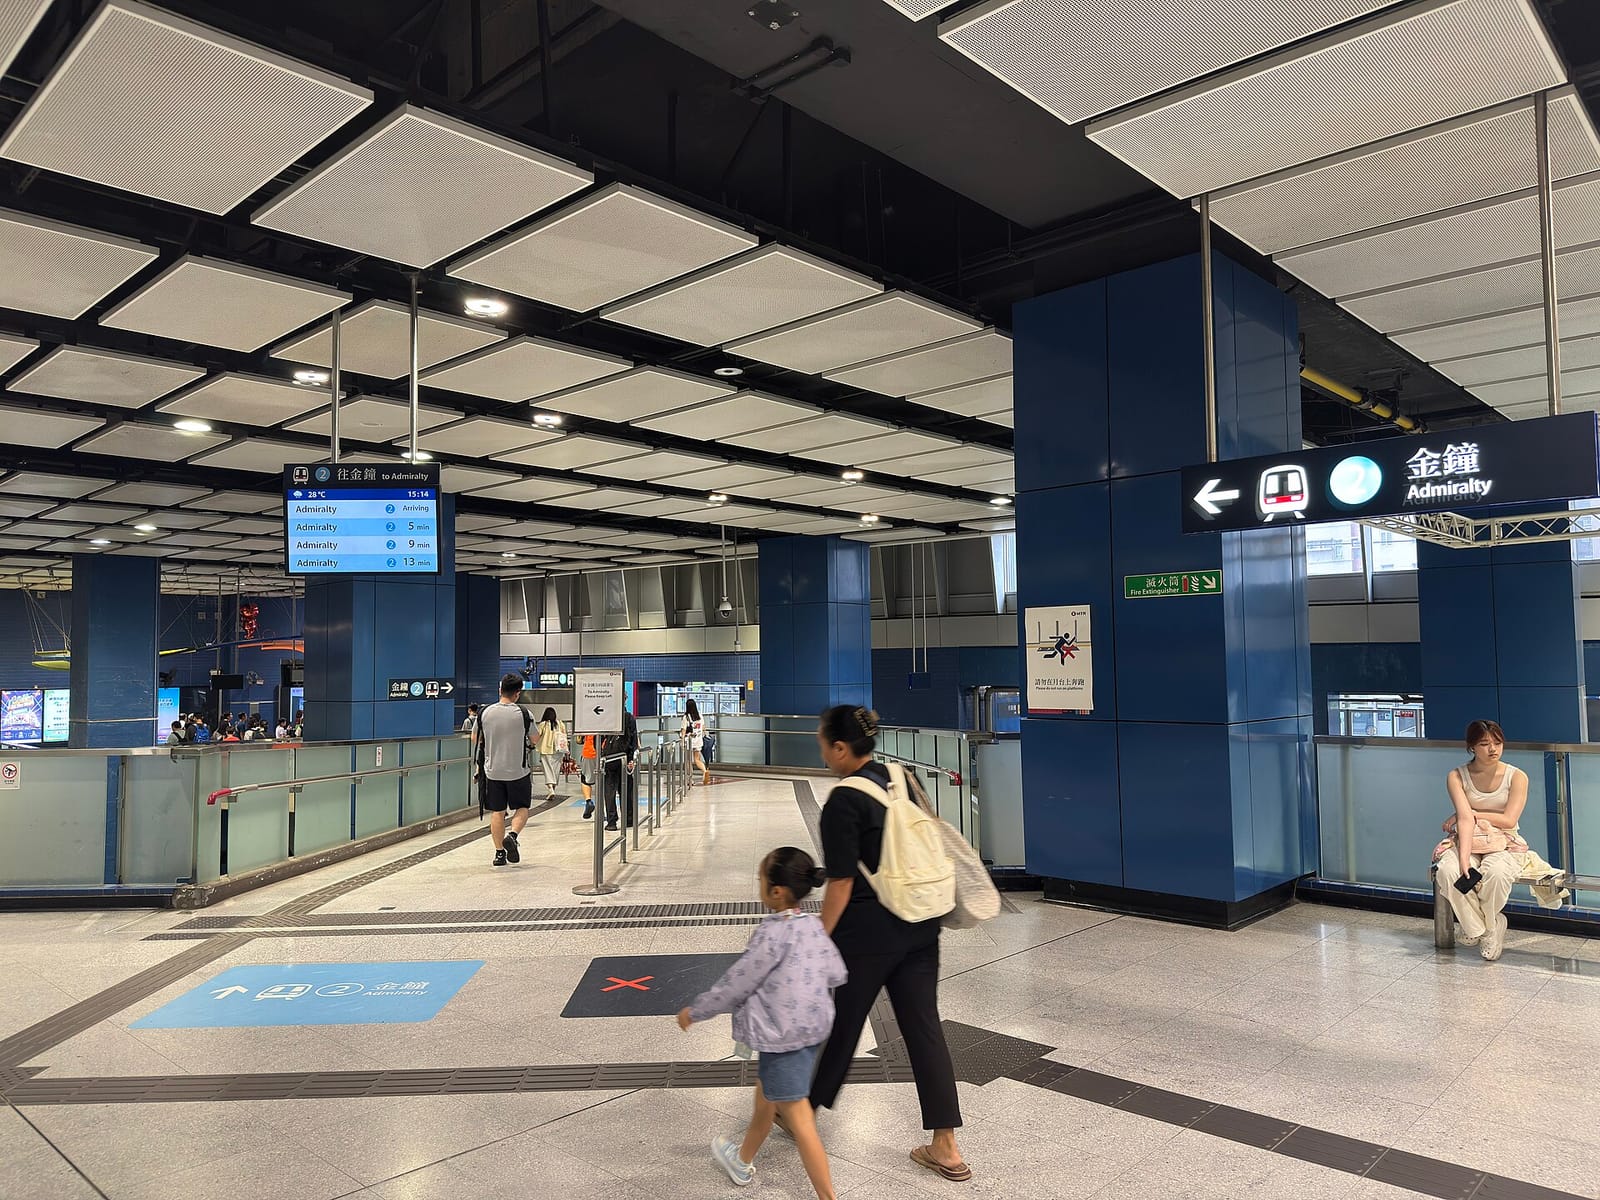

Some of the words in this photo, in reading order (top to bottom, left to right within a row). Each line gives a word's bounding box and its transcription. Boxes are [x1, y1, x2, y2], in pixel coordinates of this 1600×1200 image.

[1405, 441, 1481, 480] 金鐘
[337, 467, 377, 481] 往金鐘
[391, 472, 429, 482] Admiralty
[407, 490, 429, 498] 15:14
[1406, 478, 1493, 500] Admiralty
[295, 505, 337, 515] Admiralty
[402, 504, 429, 513] Arriving
[296, 523, 338, 533] Admiralty
[408, 522, 414, 530] 5
[296, 541, 338, 551] Admiralty
[408, 540, 415, 548] 9
[296, 559, 338, 568] Admiralty
[403, 557, 415, 566] 13
[1145, 575, 1179, 588] 滅火筒
[1142, 588, 1180, 596] Extinguisher
